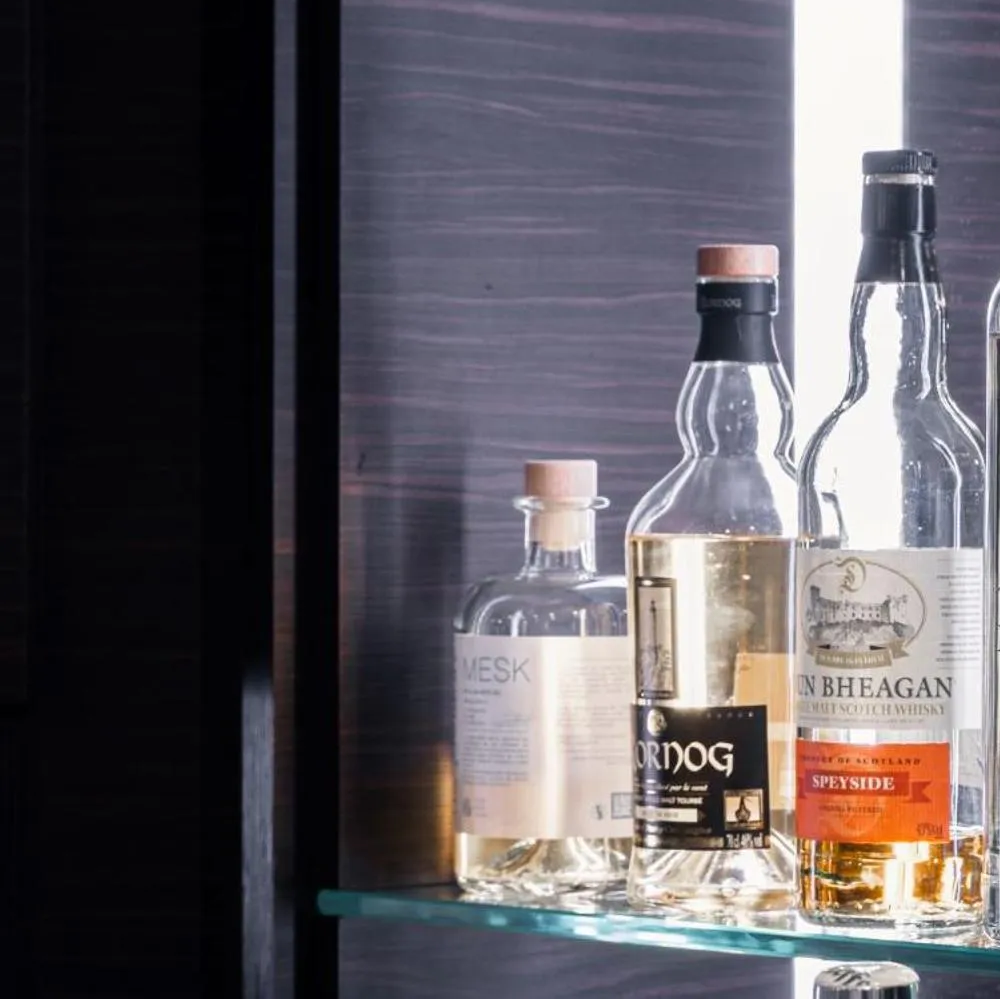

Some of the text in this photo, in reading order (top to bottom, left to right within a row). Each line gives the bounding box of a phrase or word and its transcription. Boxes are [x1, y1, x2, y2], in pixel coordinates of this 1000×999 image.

[822, 675, 954, 700] BHEAGAN
[893, 703, 946, 716] WHISKY
[811, 774, 896, 791] SPEYSIDE
